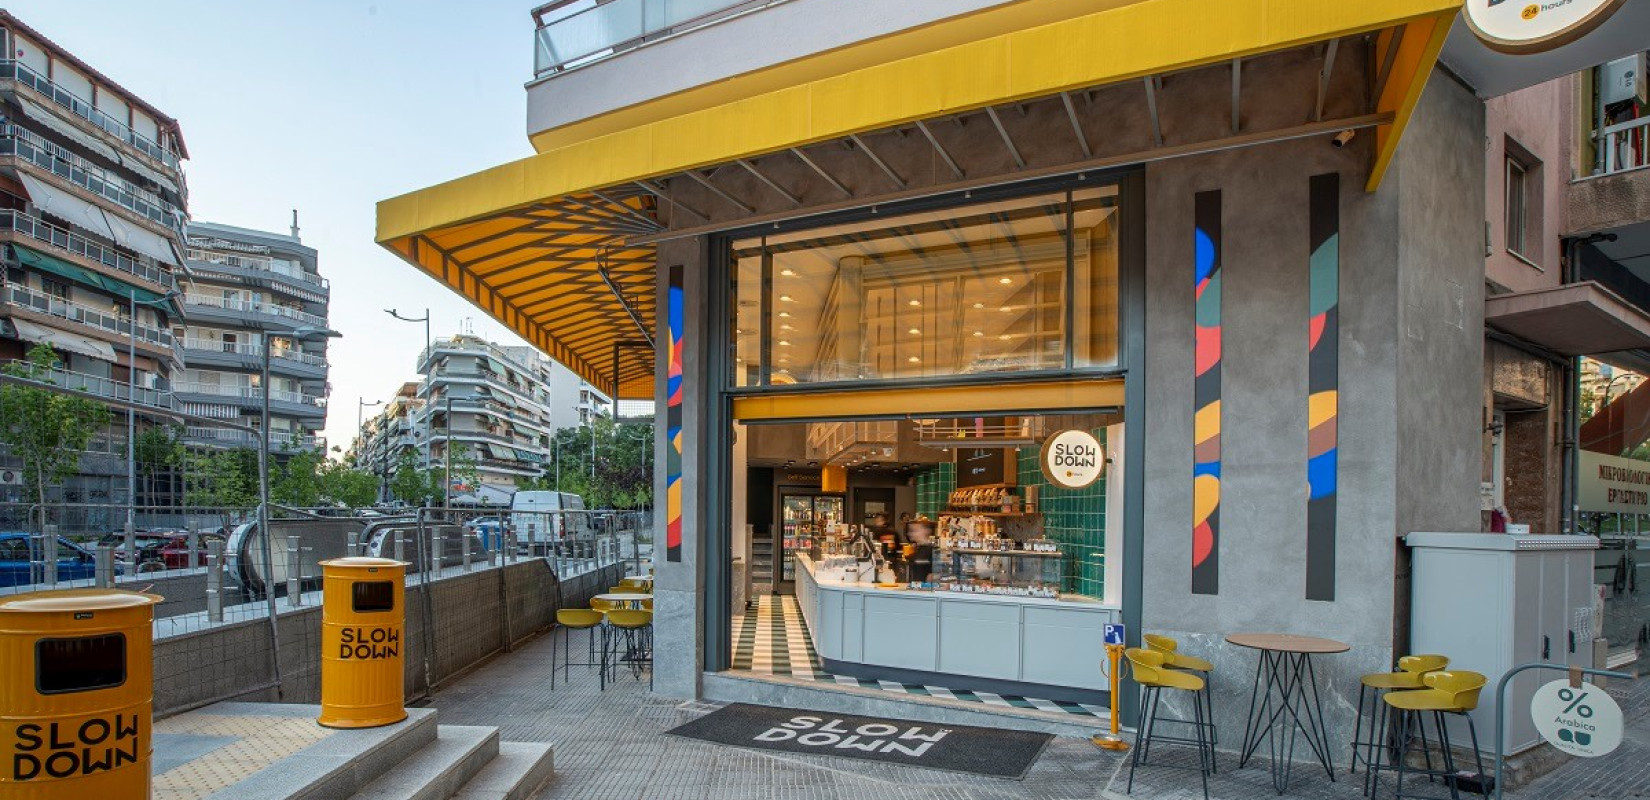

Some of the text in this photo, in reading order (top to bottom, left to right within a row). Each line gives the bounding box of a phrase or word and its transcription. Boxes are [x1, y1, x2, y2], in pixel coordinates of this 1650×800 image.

[1524, 7, 1538, 17] 24
[1055, 443, 1096, 456] SLOW
[1055, 455, 1095, 467] DOWN
[340, 627, 399, 644] SLOW
[1105, 625, 1114, 637] P
[340, 642, 399, 660] DOWN
[14, 714, 138, 751] SLOW
[780, 715, 953, 743] SLOW
[1554, 716, 1596, 732] Arabica
[753, 726, 935, 757] DOWN
[13, 737, 138, 781] DOWN
